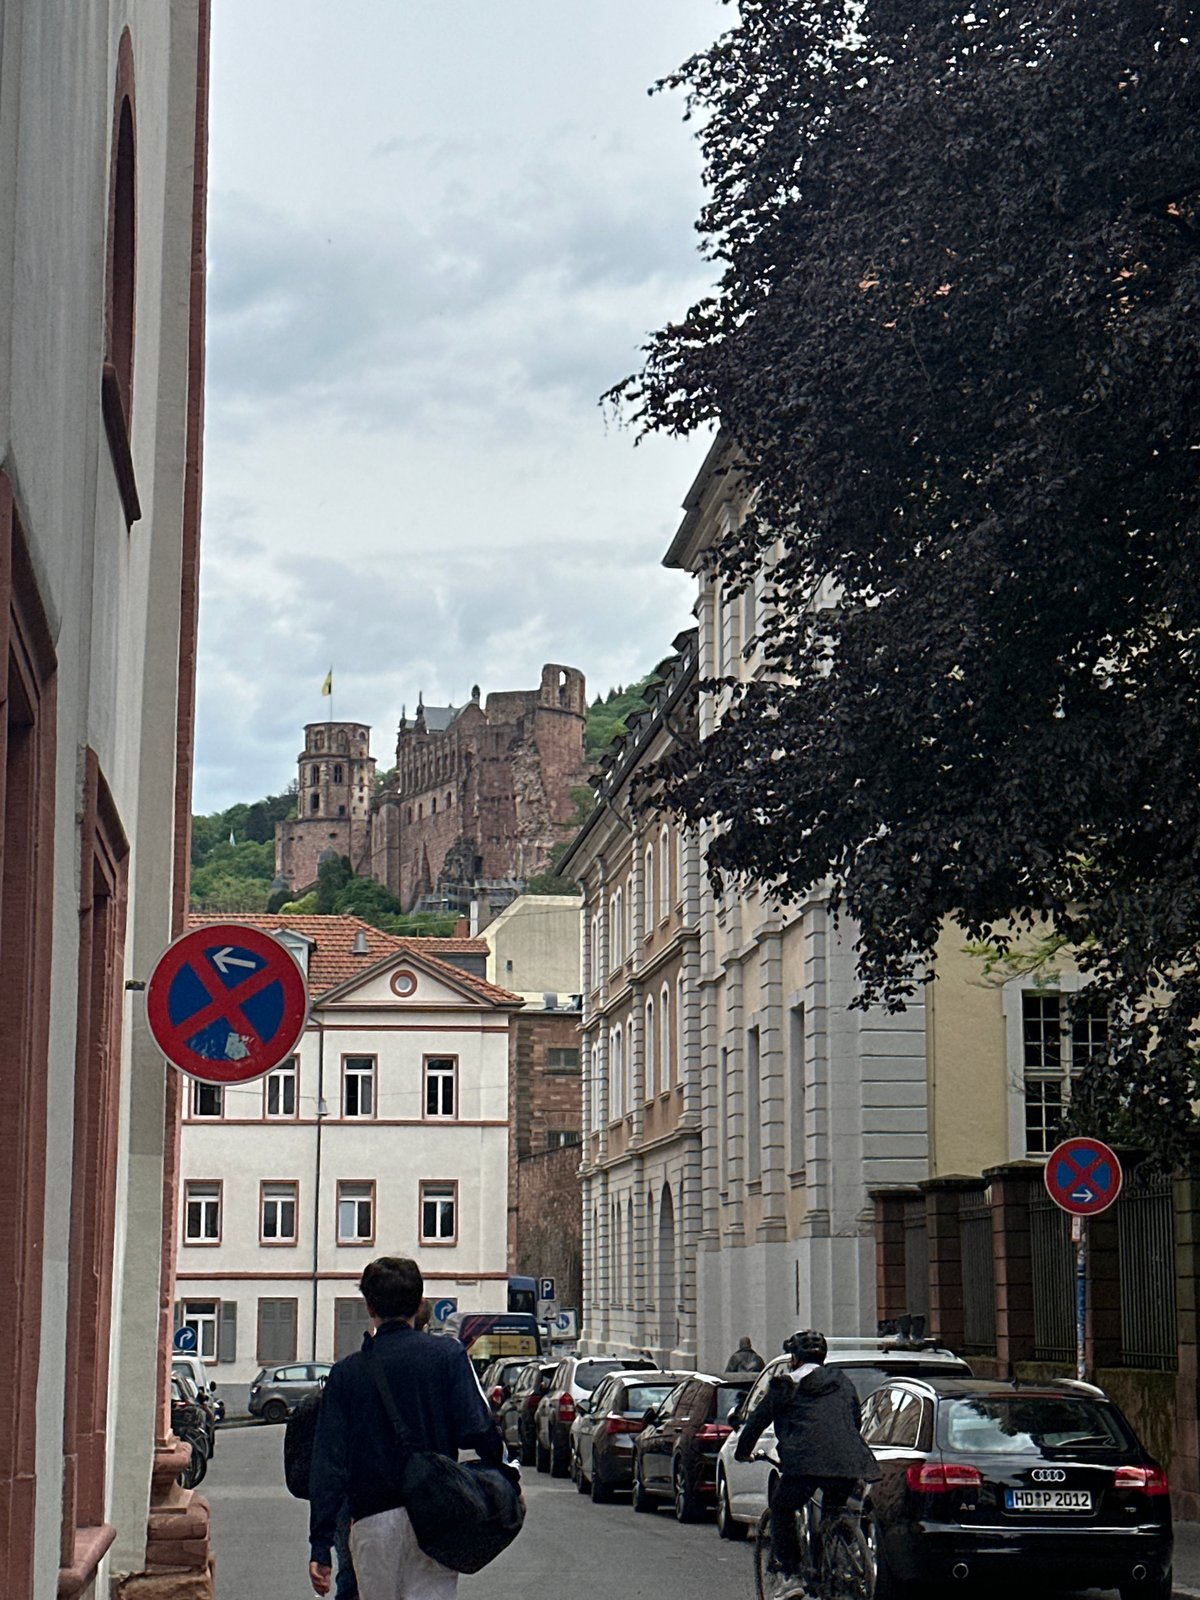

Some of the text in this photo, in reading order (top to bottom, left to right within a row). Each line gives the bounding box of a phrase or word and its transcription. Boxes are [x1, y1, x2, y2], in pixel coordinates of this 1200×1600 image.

[543, 1280, 552, 1298] P
[1015, 1492, 1090, 1507] HD P 2012
